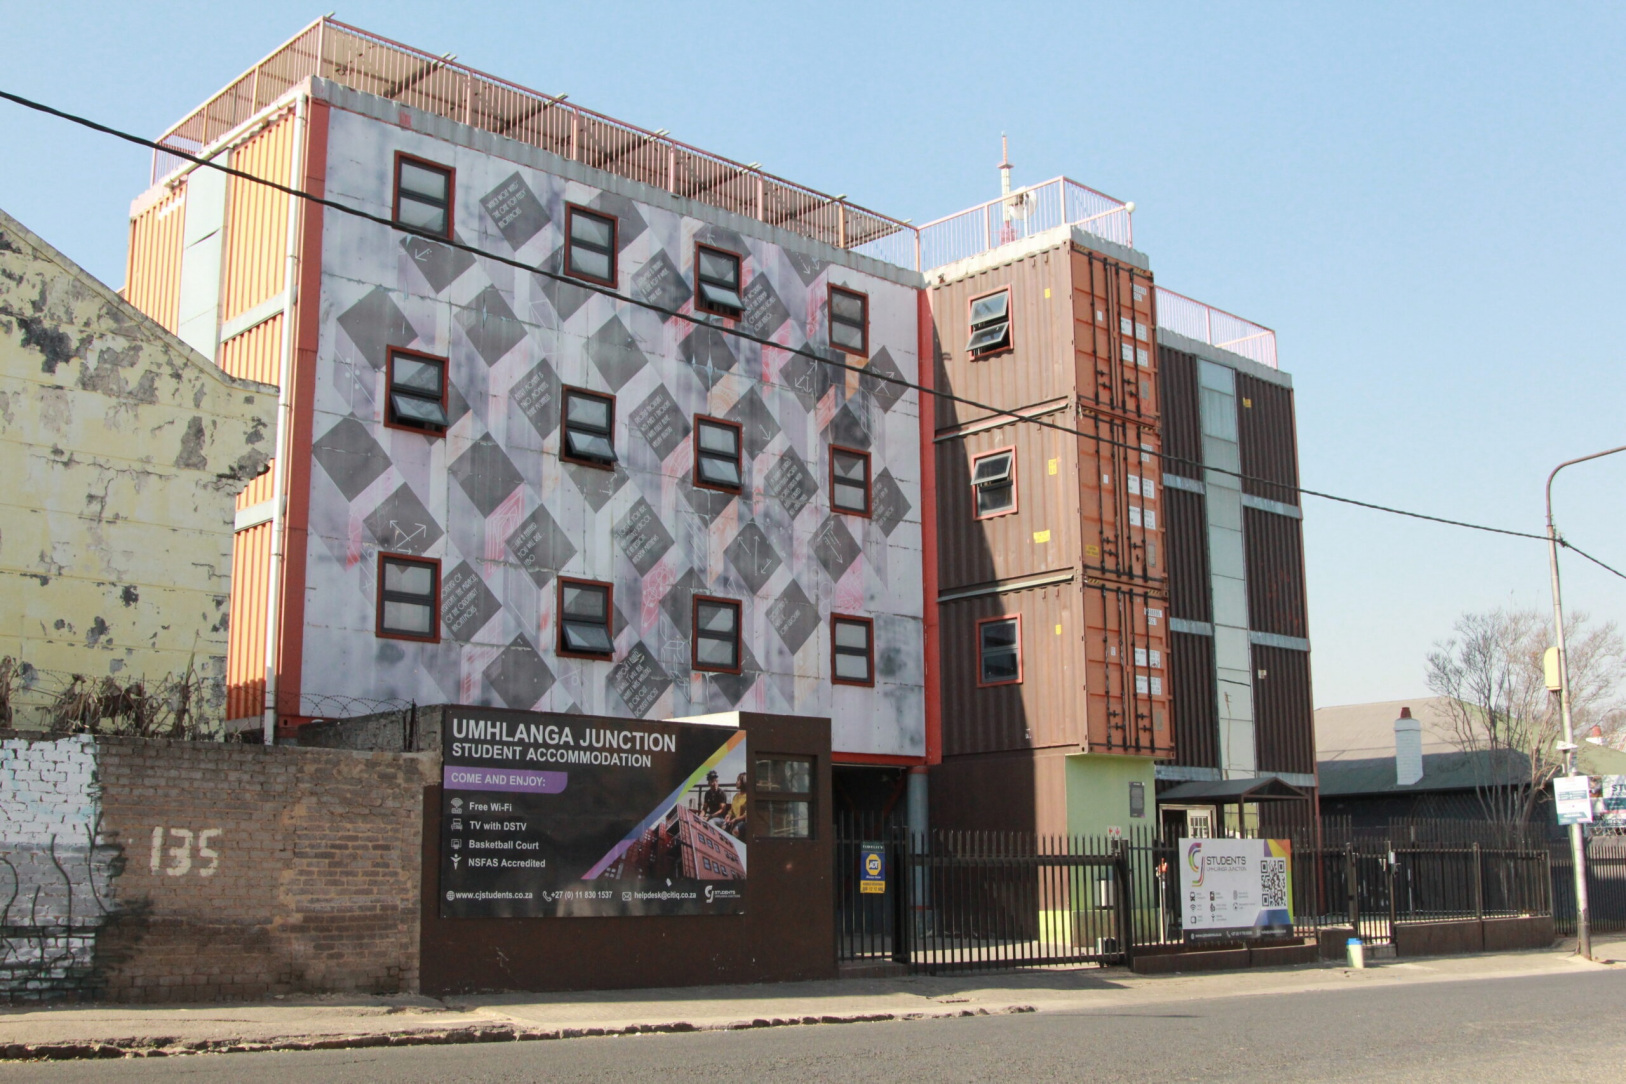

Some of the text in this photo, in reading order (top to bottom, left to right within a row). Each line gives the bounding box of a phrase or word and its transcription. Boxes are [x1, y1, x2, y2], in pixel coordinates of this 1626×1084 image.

[453, 719, 676, 752] UMHLANGA JUNCTION
[452, 743, 651, 767] STUDENT ACCOMMODATION
[451, 772, 546, 787] COME AND ENJOY:
[469, 802, 512, 812] Free Wi-Fi
[470, 821, 527, 831] TV with DSTV
[468, 840, 539, 850] Basketball Court
[150, 826, 222, 877] 135
[468, 858, 546, 868] NSFAS Accredited
[869, 861, 878, 869] ADT
[1206, 856, 1246, 865] STUDENTS
[455, 890, 533, 900] www.cjstudents.co.za
[551, 891, 563, 899] +27
[564, 890, 574, 899] (0)
[584, 890, 597, 899] 830
[598, 891, 613, 899] 1537
[634, 891, 697, 900] helpdesk@citiq.co.za
